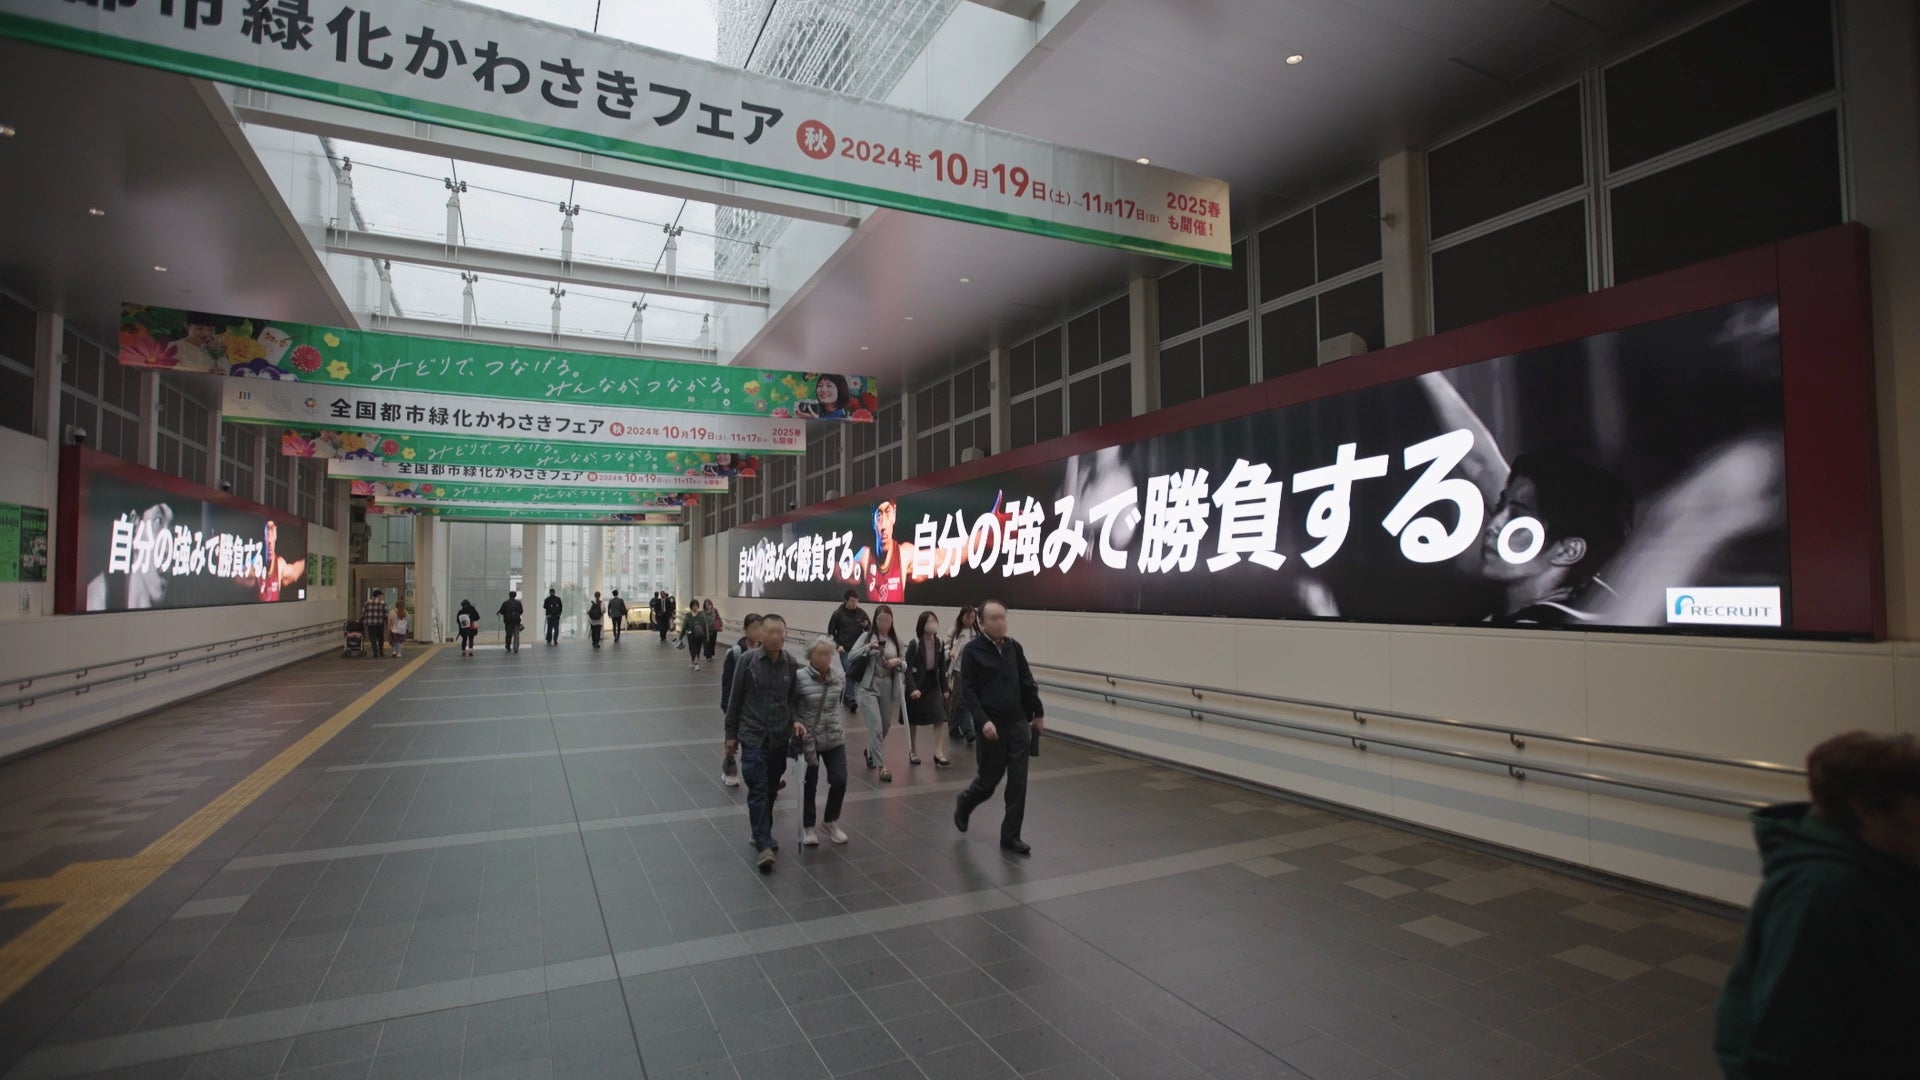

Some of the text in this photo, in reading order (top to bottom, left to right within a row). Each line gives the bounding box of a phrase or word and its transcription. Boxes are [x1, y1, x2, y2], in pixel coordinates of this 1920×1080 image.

[65, 0, 784, 145] 市緑化かわさきフェア
[801, 124, 832, 156] 秋
[1166, 191, 1221, 218] 2025春
[330, 398, 605, 435] 全国都市緑化かわさきフェア
[911, 428, 1546, 579] 自分の強みで勝負する。
[739, 531, 861, 583] 自分の強みで勝負する。
